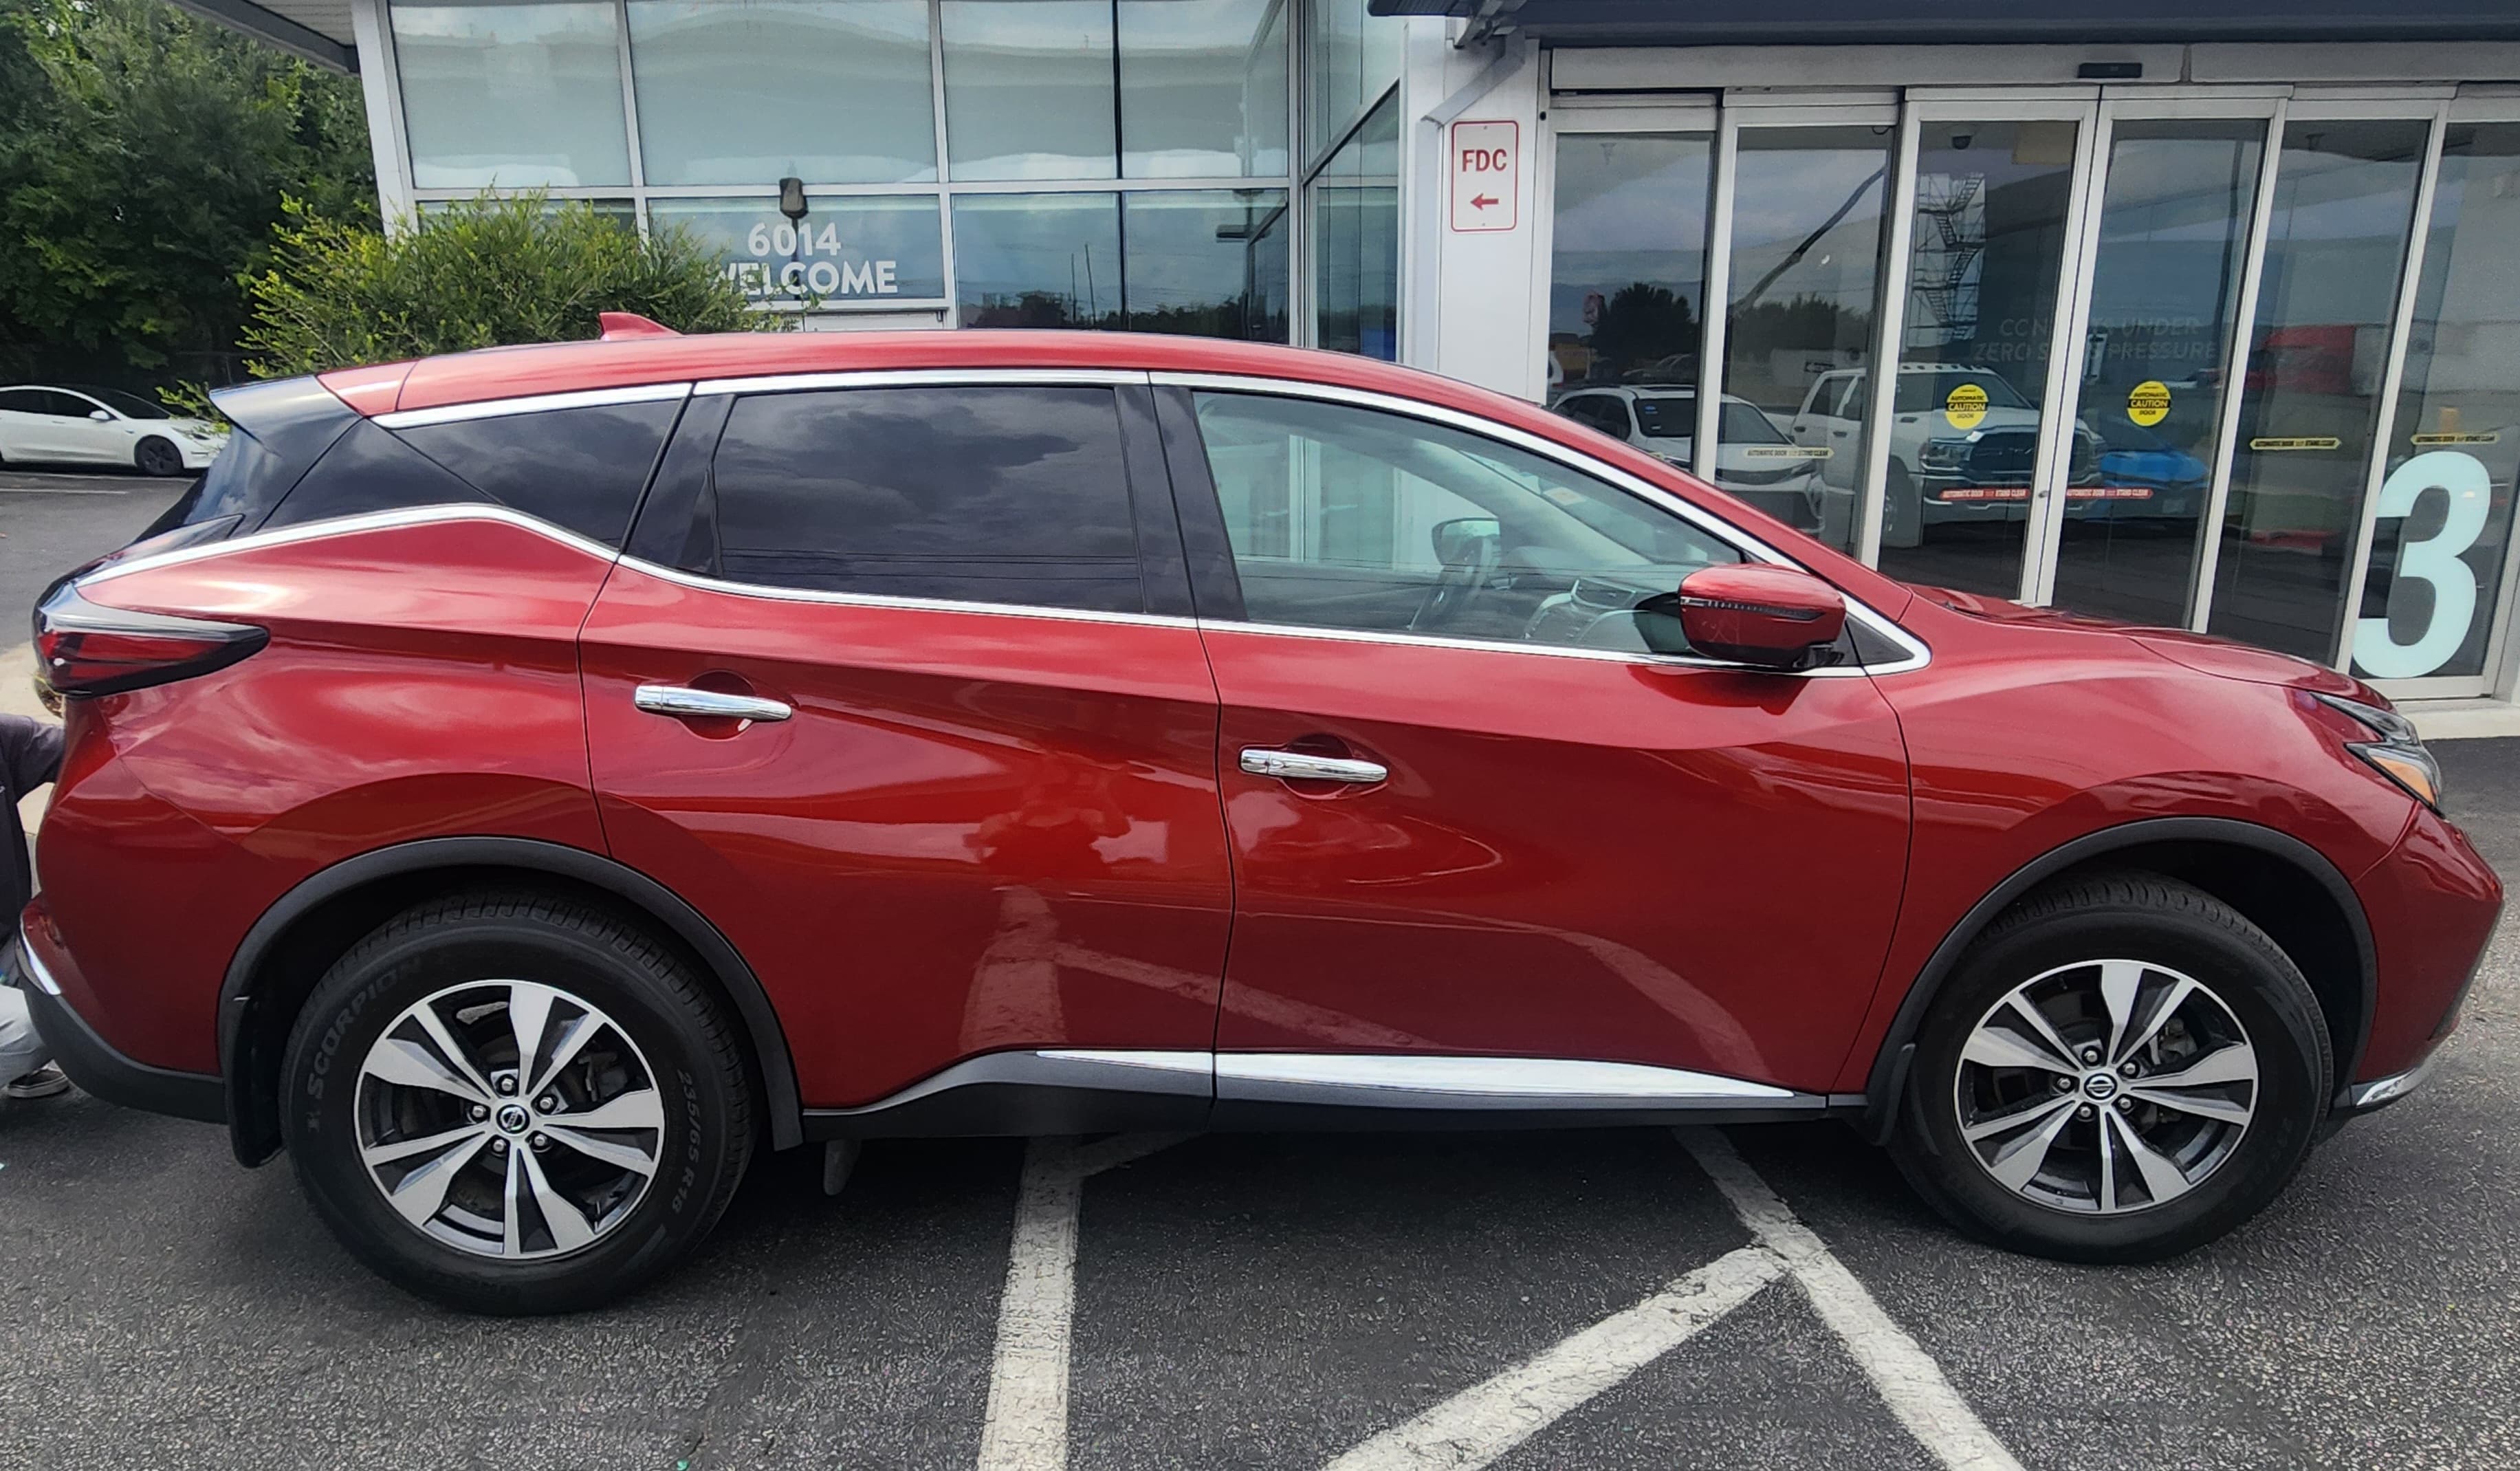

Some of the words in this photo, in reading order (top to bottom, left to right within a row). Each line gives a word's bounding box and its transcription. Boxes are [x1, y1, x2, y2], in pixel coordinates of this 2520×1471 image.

[1462, 149, 1507, 172] FDC
[747, 221, 842, 257] 6014
[2107, 341, 2217, 360] PRESSURE
[1948, 402, 1986, 411] CAUTION
[2352, 451, 2491, 679] 3
[307, 956, 421, 1100] SCORPION
[677, 1069, 701, 1163] 235/65
